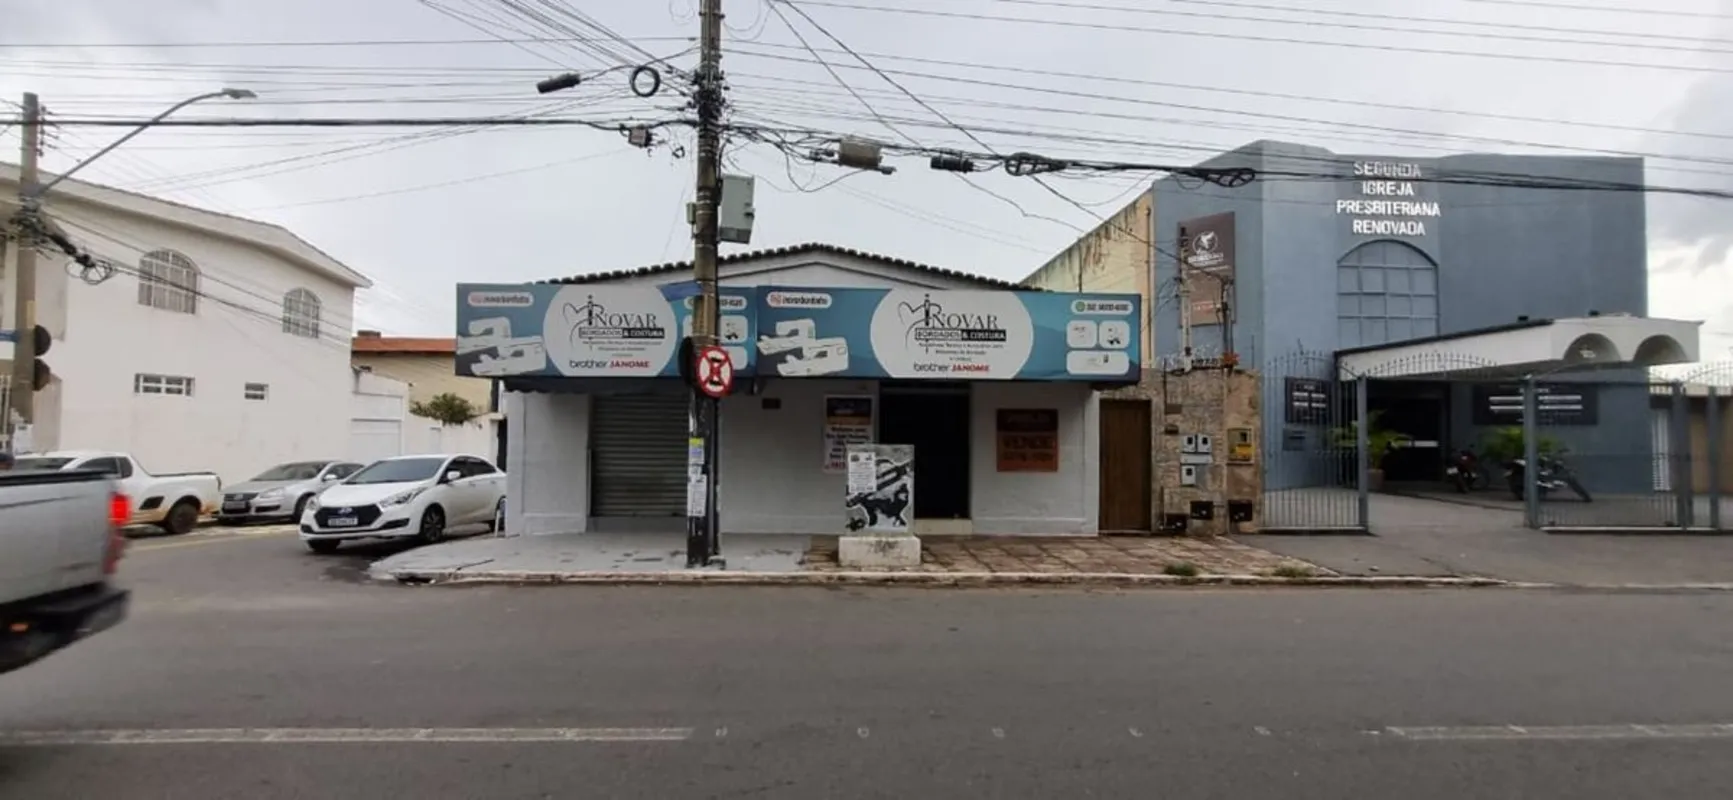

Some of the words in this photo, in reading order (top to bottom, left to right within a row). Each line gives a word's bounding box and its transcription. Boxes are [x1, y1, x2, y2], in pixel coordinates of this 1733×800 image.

[1353, 161, 1421, 177] SEGUNDA
[1362, 180, 1414, 196] IGREJA
[1336, 199, 1441, 217] PRESBITERIANA
[1352, 219, 1426, 236] RENOVADA
[569, 359, 608, 369] brother
[609, 360, 651, 369] JANOME
[914, 361, 950, 372] brother
[951, 363, 990, 373] JANOME
